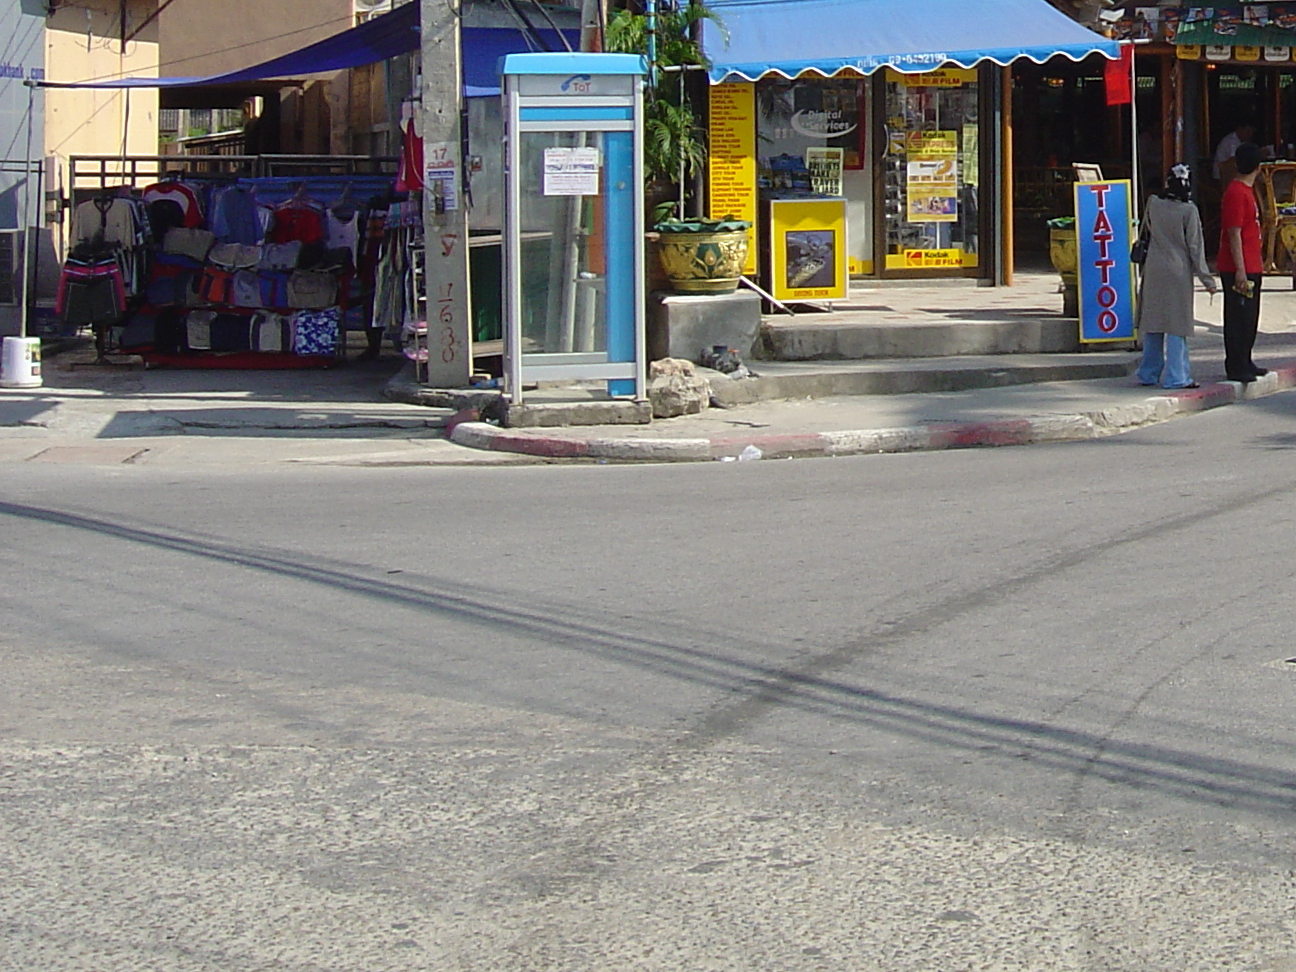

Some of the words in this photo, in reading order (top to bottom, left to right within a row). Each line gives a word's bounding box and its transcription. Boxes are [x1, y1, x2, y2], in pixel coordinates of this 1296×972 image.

[808, 110, 842, 120] Digital
[432, 147, 448, 160] 17
[942, 258, 963, 266] FILM
[1089, 184, 1119, 334] TATTOO
